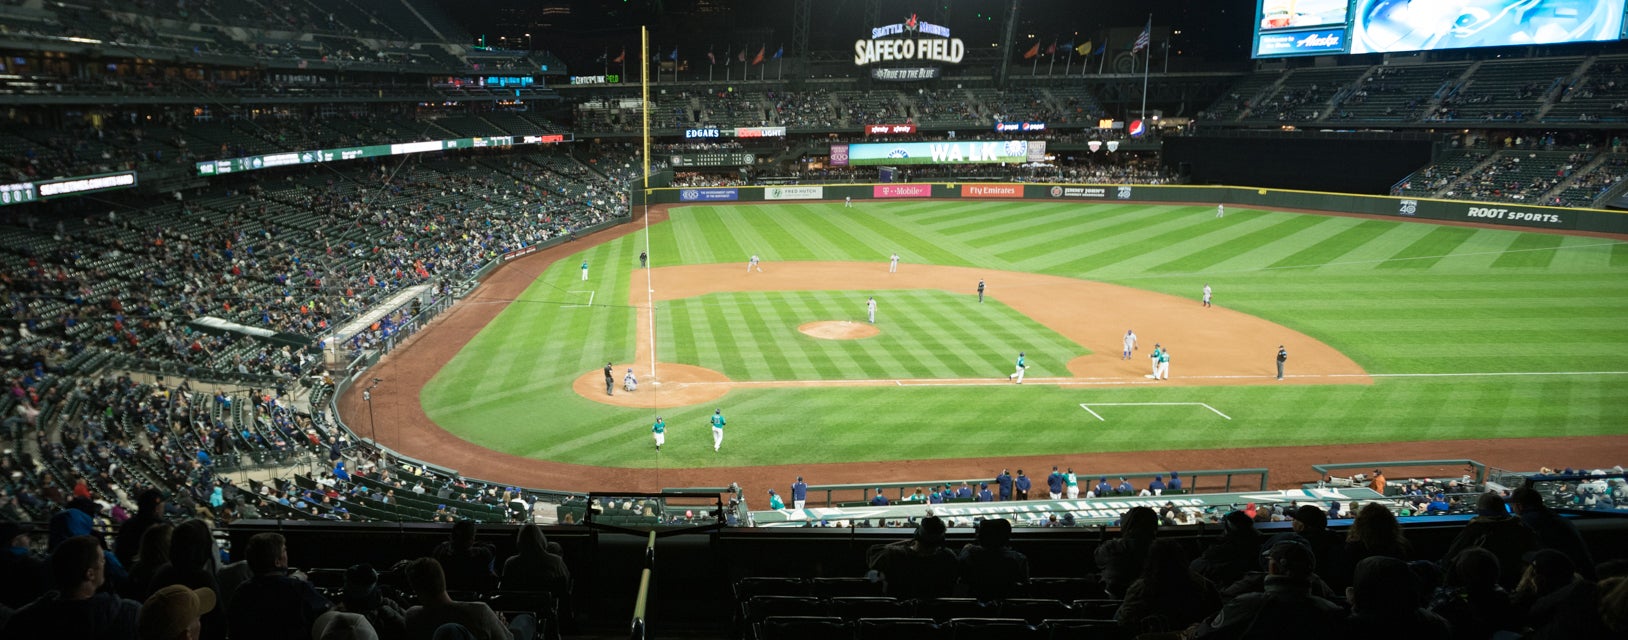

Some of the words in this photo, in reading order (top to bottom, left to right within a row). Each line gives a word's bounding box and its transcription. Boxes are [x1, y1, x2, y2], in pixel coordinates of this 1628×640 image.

[872, 23, 903, 39] SEATTLE
[855, 39, 915, 65] SAFECO
[917, 38, 964, 63] FIELD
[882, 68, 898, 79] TRUE
[900, 69, 907, 78] TO
[907, 69, 918, 78] THE
[919, 68, 934, 78] BLUE
[762, 129, 782, 137] LIGHT
[930, 142, 998, 162] WALK
[1468, 207, 1506, 218] ROOT
[1508, 212, 1559, 222] SPORTS
